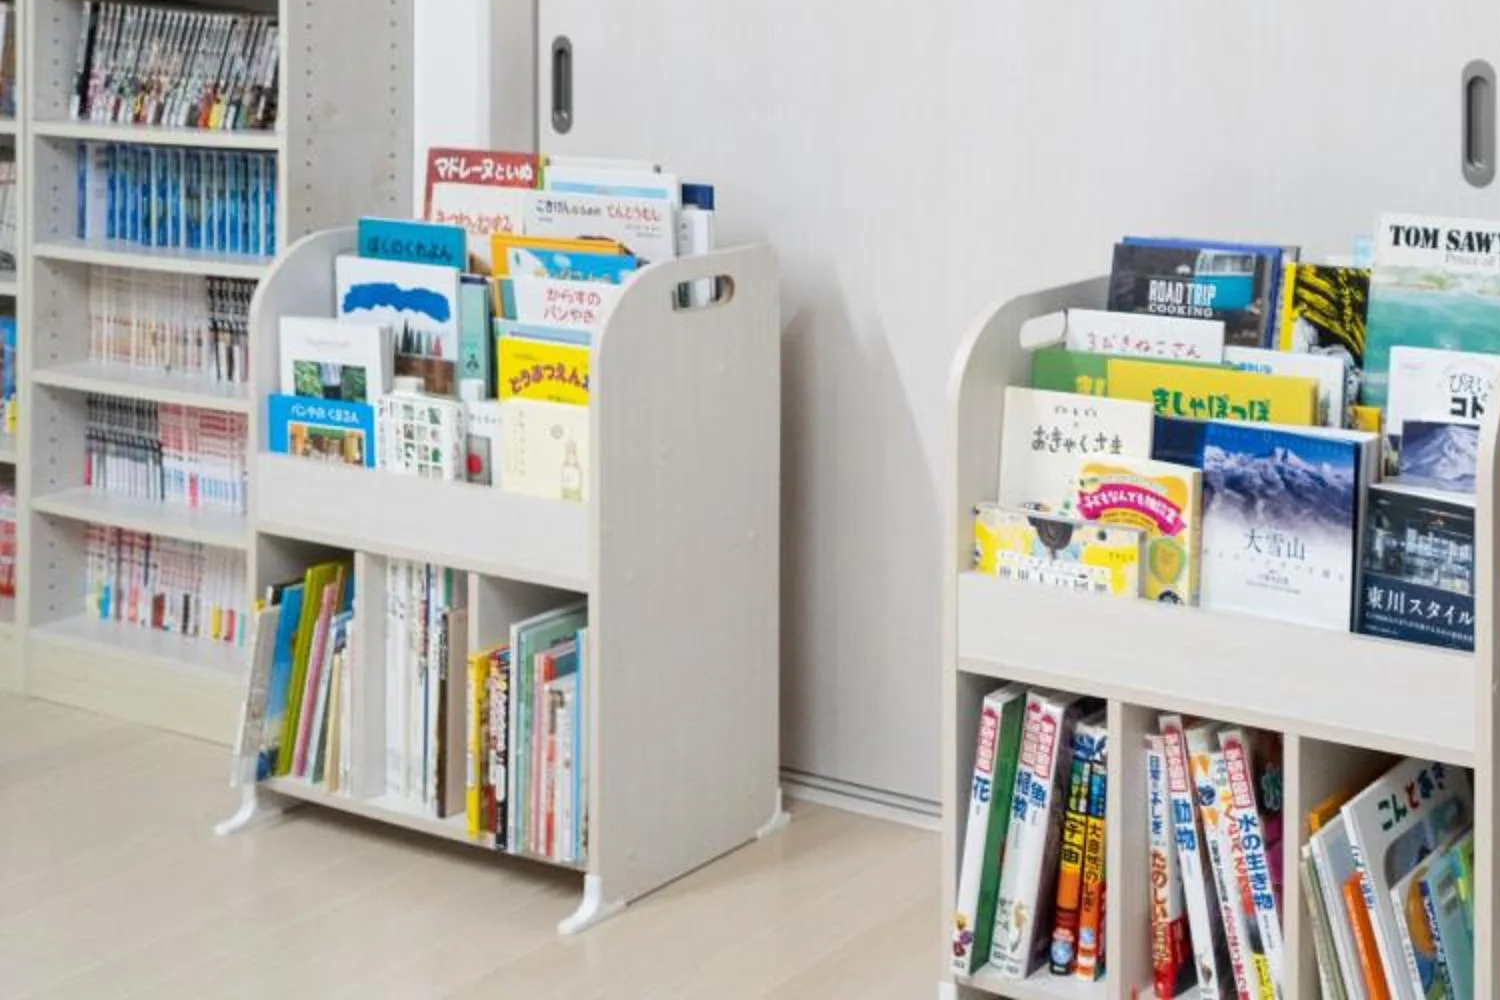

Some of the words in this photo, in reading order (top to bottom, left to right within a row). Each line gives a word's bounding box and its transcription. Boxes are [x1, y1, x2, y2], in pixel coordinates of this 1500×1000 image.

[434, 157, 534, 182] マドレーヌといぬ
[1390, 224, 1439, 250] TOM
[1149, 279, 1183, 305] ROAD
[1187, 282, 1217, 308] TRIP
[1149, 302, 1213, 318] COOKING
[1152, 387, 1271, 423] きしゃぽっぽ
[1031, 425, 1123, 454] おきゃくさま
[1246, 527, 1306, 562] 大雪山
[1366, 586, 1475, 626] 東川スタイル
